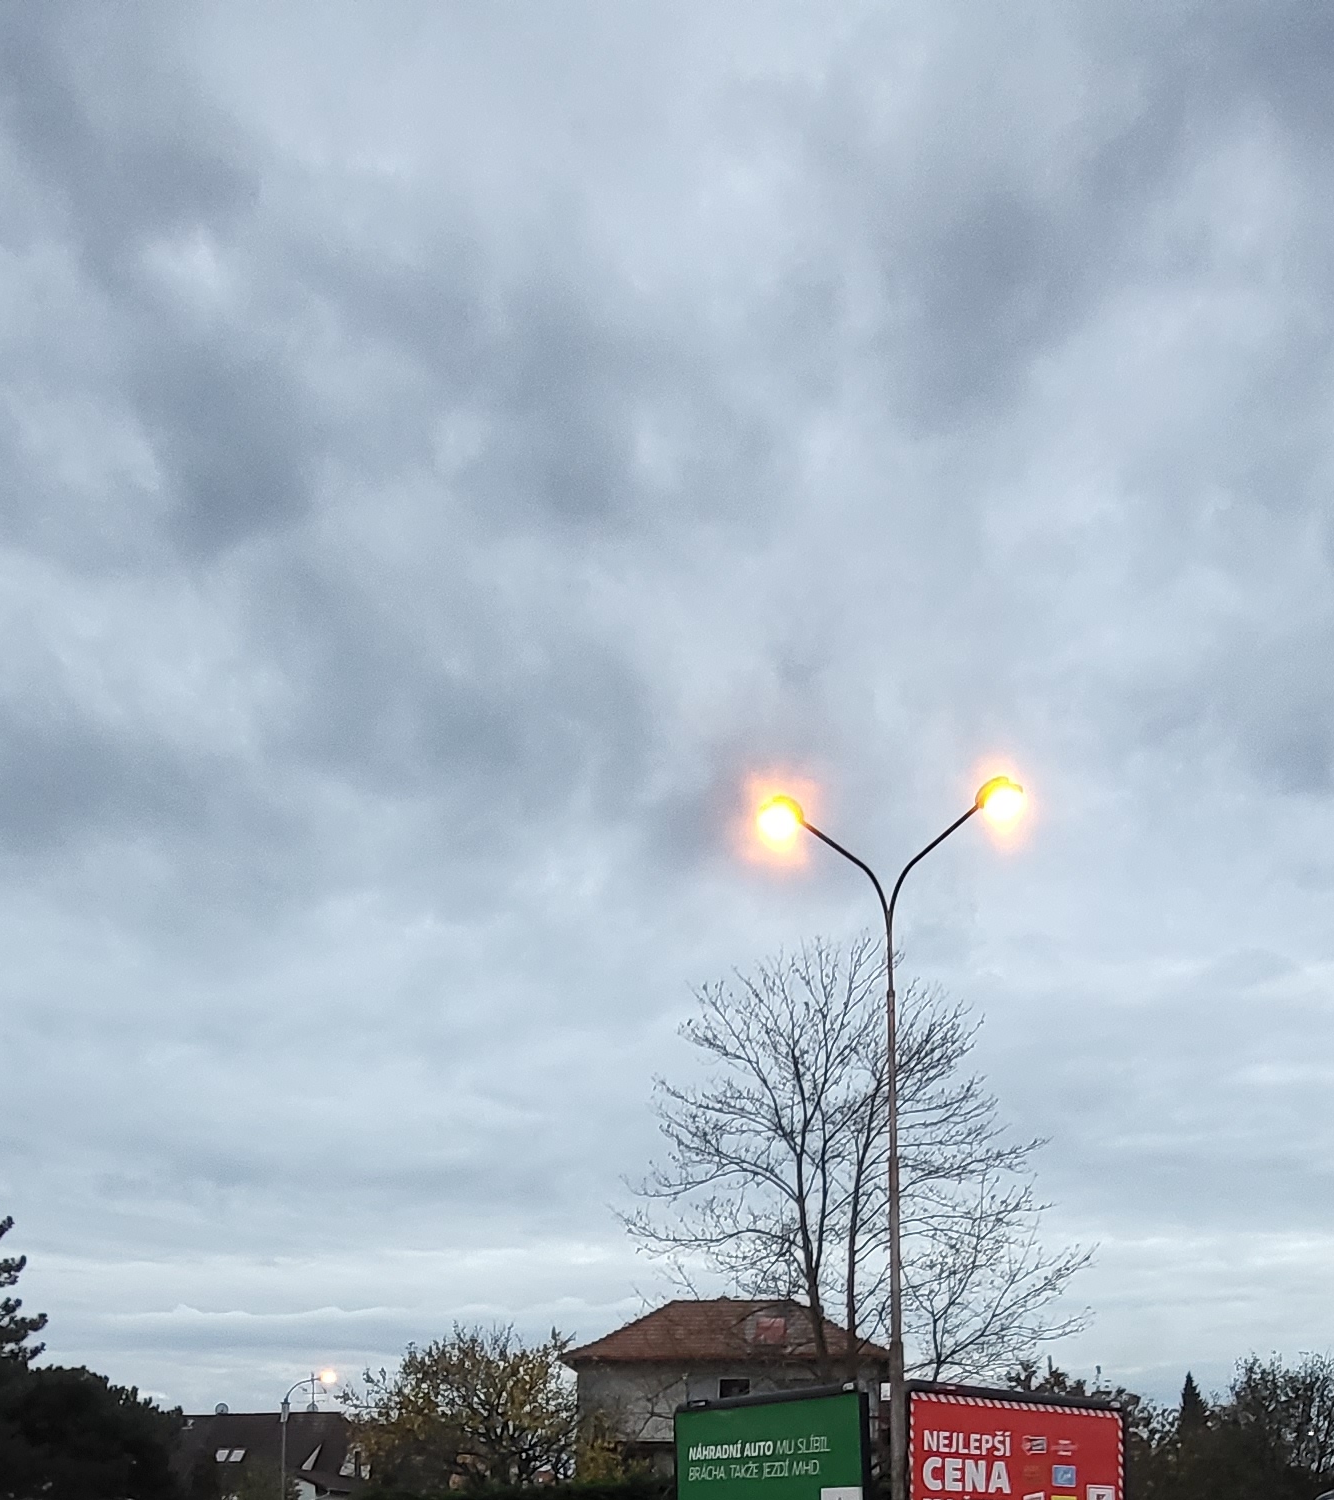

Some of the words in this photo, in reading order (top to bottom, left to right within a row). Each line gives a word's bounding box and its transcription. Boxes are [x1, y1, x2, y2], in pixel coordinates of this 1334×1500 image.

[688, 1439, 742, 1461] NÁHRADNÍ
[744, 1441, 773, 1457] AUTO
[775, 1439, 795, 1455] MU
[923, 1429, 1012, 1456] NEJLEPŠÍ
[729, 1460, 759, 1478] TAKŽE
[762, 1457, 789, 1479] JEZDÍ
[922, 1456, 1012, 1494] CENA
